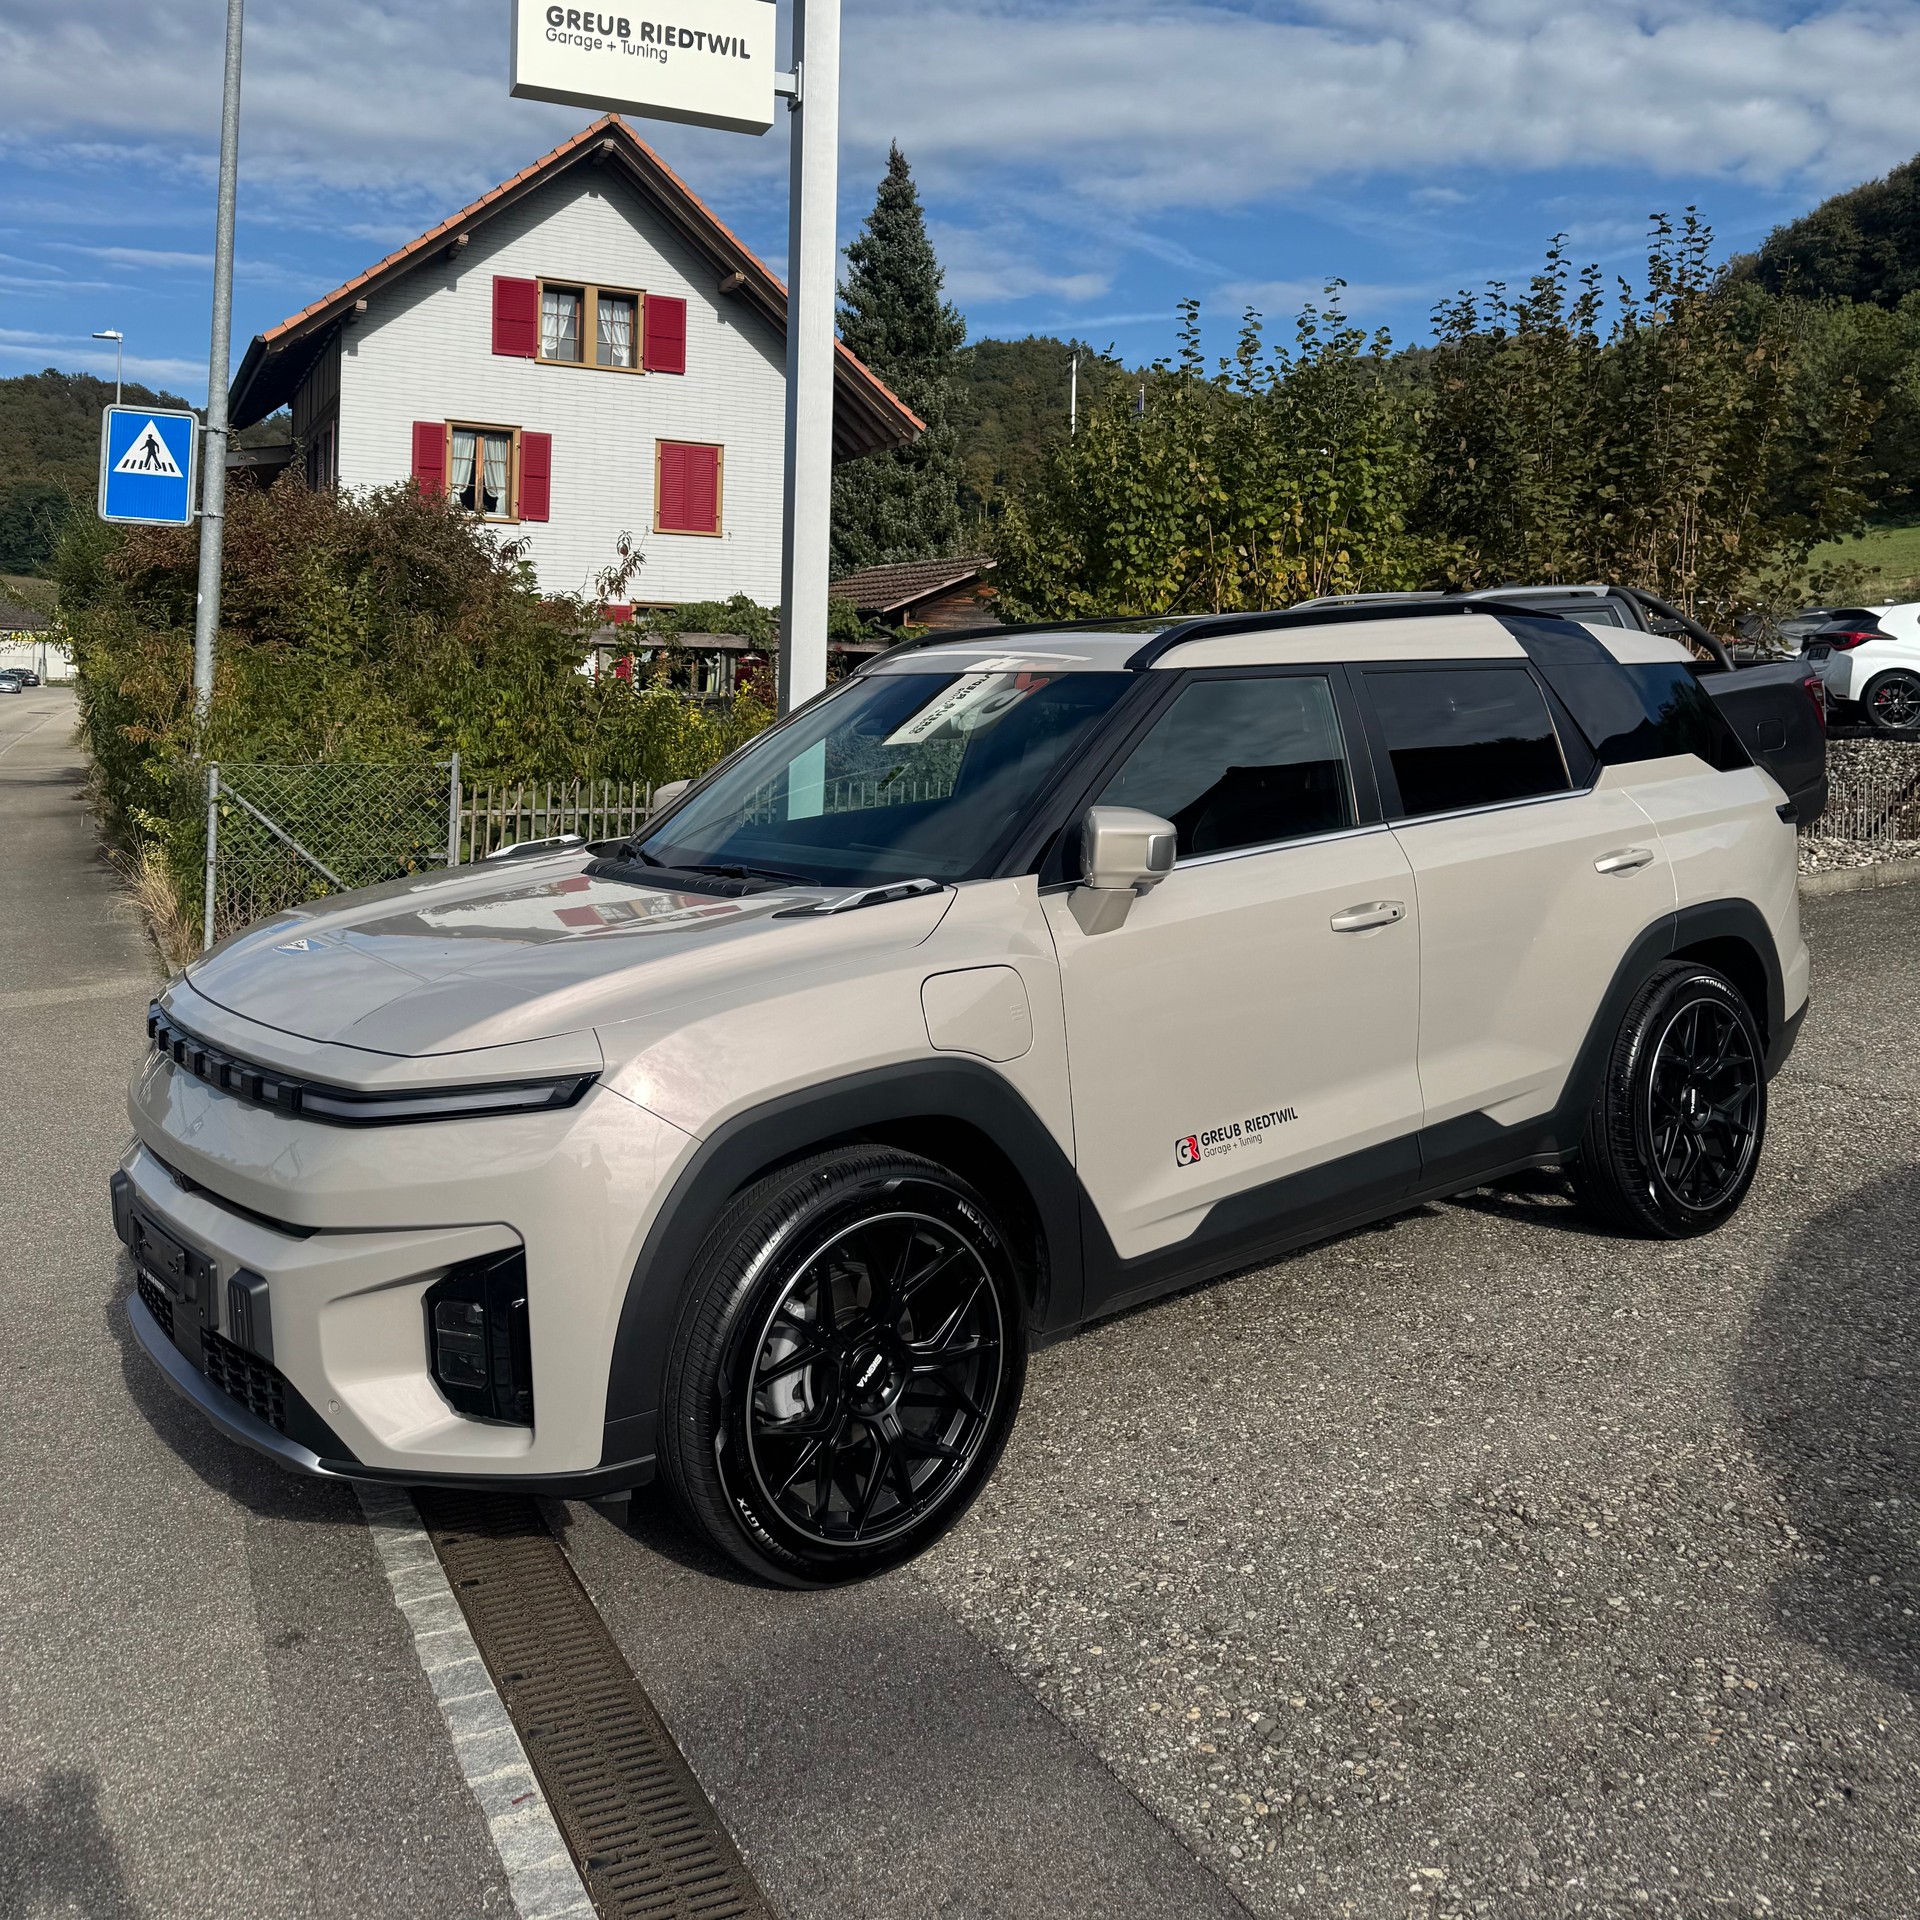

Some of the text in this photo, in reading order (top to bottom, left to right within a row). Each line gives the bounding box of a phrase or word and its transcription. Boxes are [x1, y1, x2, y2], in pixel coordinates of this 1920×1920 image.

[545, 27, 668, 64] Garage + Tuning
[546, 5, 751, 60] GREUB RIEDTWIL
[1200, 1107, 1298, 1146] GREUB RIEDTWIL
[1203, 1143, 1232, 1158] Garage
[1238, 1133, 1263, 1148] Tuning
[957, 1199, 999, 1248] NEXEN
[736, 1497, 760, 1528] GTX
